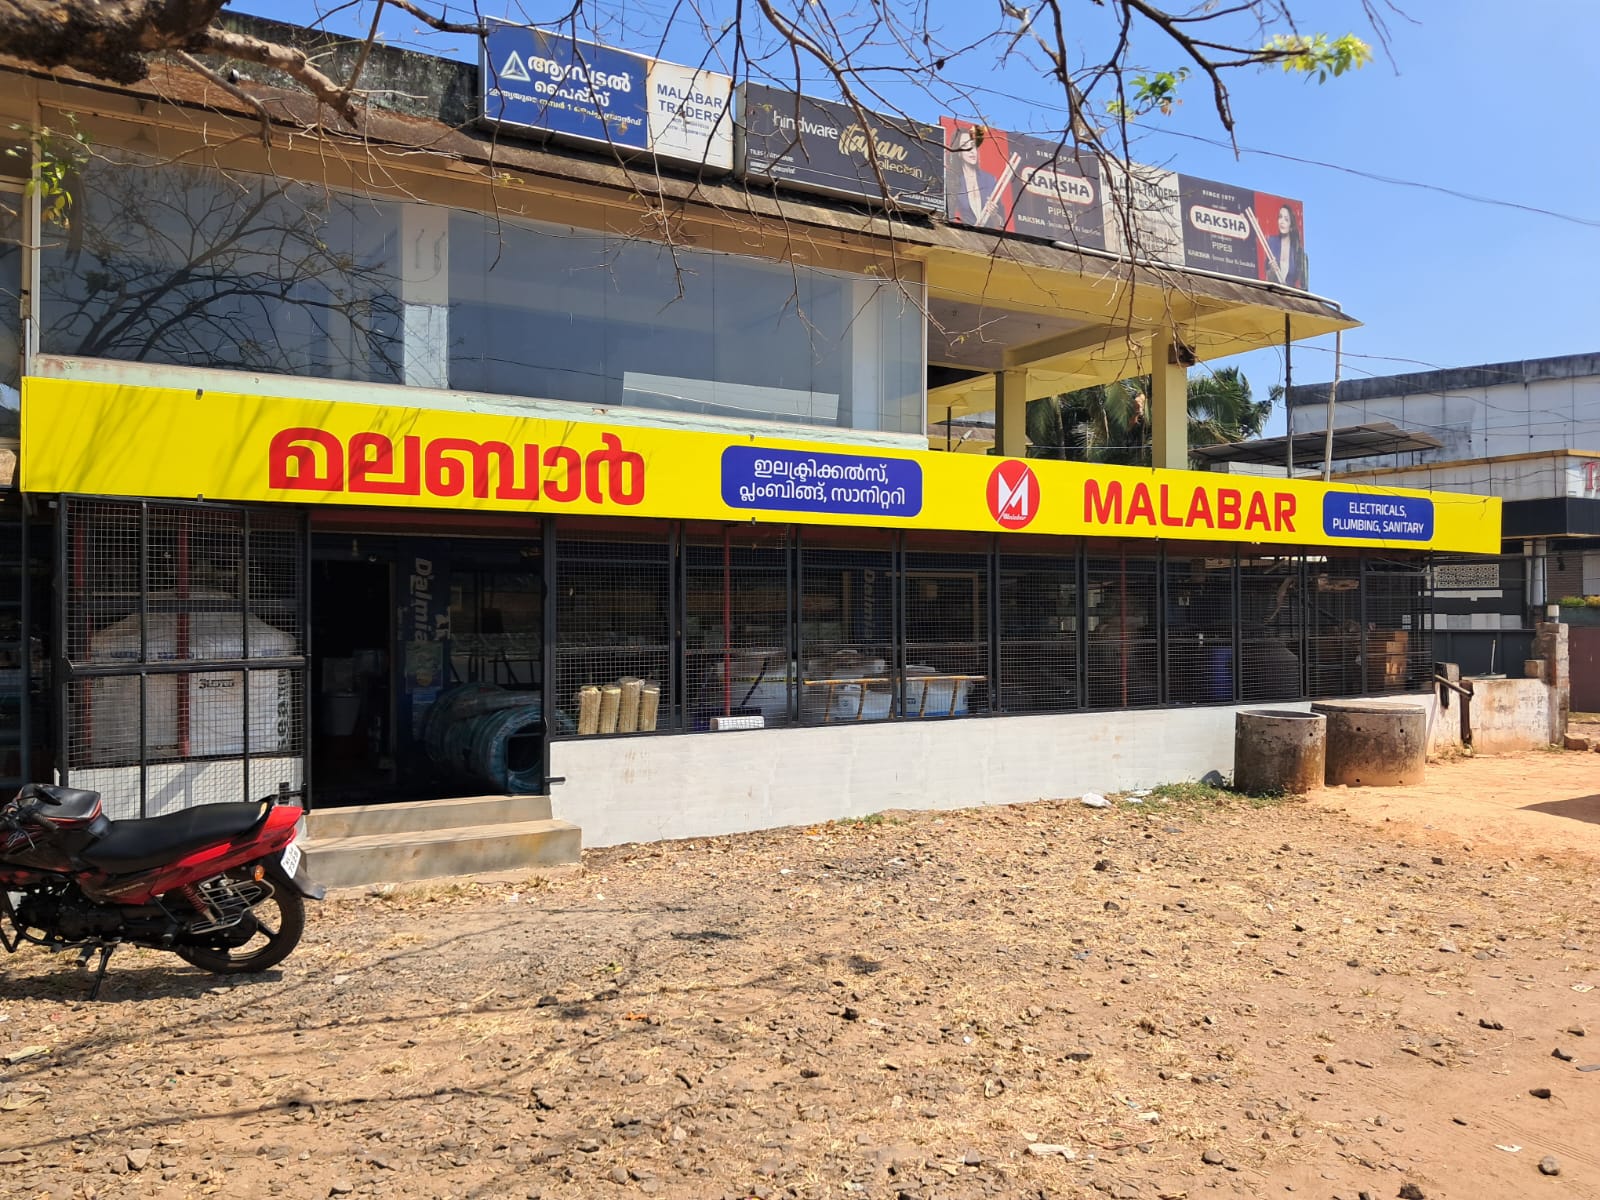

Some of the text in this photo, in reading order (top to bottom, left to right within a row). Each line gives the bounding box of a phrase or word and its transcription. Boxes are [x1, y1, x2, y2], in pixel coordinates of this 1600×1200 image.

[657, 83, 722, 109] MALABAR
[773, 110, 838, 140] hindware
[1036, 150, 1056, 159] SINC
[872, 158, 923, 178] ollection
[1027, 173, 1090, 198] RAKSHA
[1101, 171, 1141, 194] MLAR
[1047, 206, 1073, 219] PIPES
[1195, 211, 1247, 233] RAKSHA
[1212, 241, 1233, 253] PIPES
[268, 426, 646, 507] മലബാർ
[1083, 478, 1297, 533] MALABAR
[1349, 501, 1407, 518] ELECTRICALS,
[1332, 517, 1425, 534] PLUMBING, SANITARY
